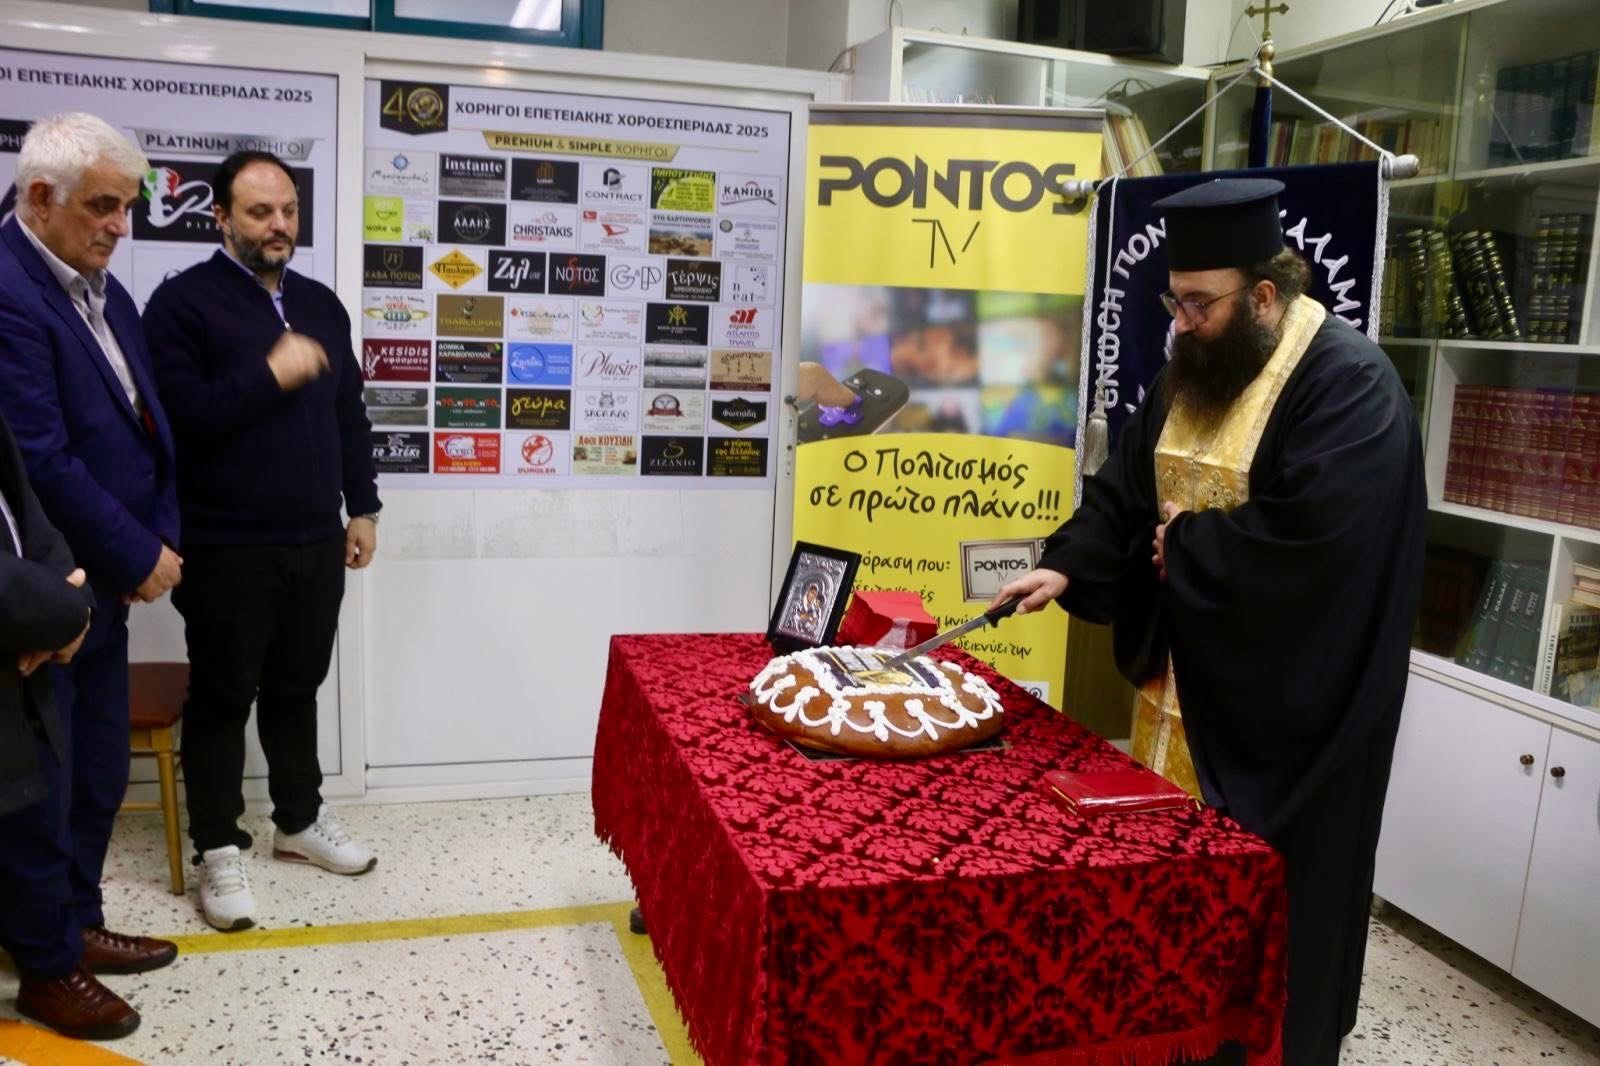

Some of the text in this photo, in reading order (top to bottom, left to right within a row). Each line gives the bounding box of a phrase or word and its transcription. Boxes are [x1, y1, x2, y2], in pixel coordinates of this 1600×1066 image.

[17, 68, 126, 90] ΕΠΕΤΕΙΑΚΗΣ
[132, 78, 270, 100] ΧΟΡΟΕΣΠΕΡΙΔΑΣ
[274, 88, 313, 103] 2025
[455, 101, 769, 138] ΧΟΡΗΓΟΙ ΕΠΕΤΕΙΑΚΗΣ ΧΟΡΟΕΣΠΕΡΙΔΑΣ 2025
[146, 135, 304, 154] PLATINUM ΧΟΡΗΓΟΙ
[495, 136, 553, 148] PREMIUM
[568, 140, 611, 152] SIMPLE
[615, 142, 668, 157] ΧΟΡΗΓΟΙ
[445, 157, 503, 173] instante
[724, 186, 774, 198] KANIDIS
[818, 154, 1088, 215] PONTOS
[585, 190, 643, 201] CONTRACT
[514, 224, 573, 238] CHRISTAKIS
[911, 218, 980, 268] TV
[555, 266, 600, 283] ΝΟΤΟΣ
[729, 340, 756, 348] TRAVEL
[844, 448, 1029, 489] Ο Πολιτισμός
[810, 484, 1060, 523] σε πρώτο πλάνο!!!
[917, 559, 950, 572] που:
[974, 558, 1028, 572] PONTOS
[1009, 643, 1032, 660] την
